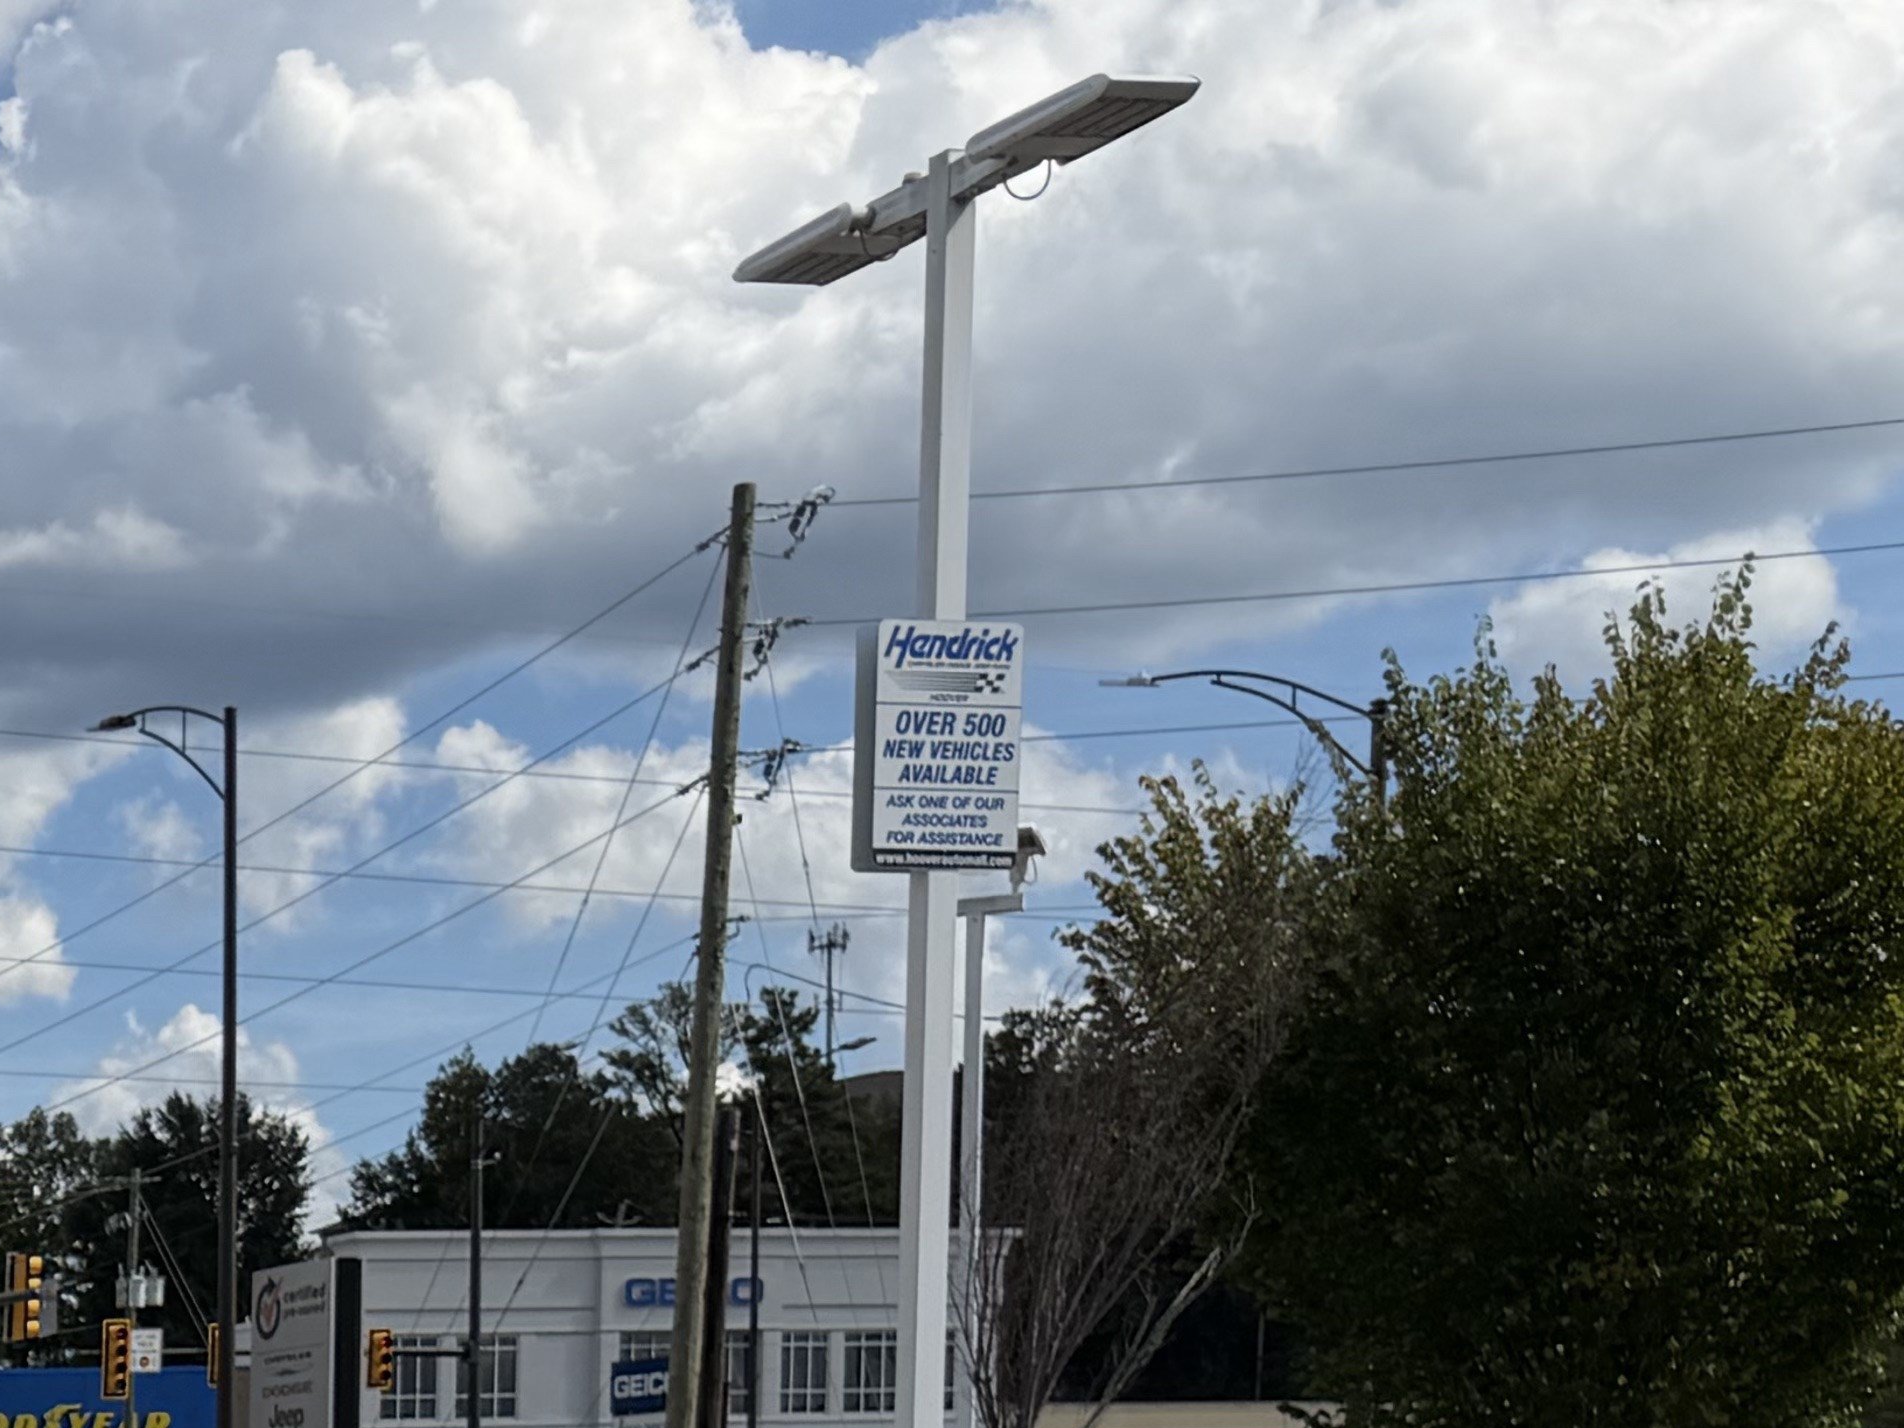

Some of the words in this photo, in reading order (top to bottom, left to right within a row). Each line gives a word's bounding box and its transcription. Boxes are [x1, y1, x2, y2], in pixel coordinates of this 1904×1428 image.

[884, 625, 1019, 668] Hendrick
[896, 710, 956, 735] OVER
[962, 712, 1006, 737] 500
[882, 739, 925, 759] NEW
[929, 741, 1015, 762] VEHICLES
[898, 764, 998, 786] AVAILABLE
[886, 794, 915, 808] ASK
[918, 795, 949, 810] ONE
[952, 796, 972, 810] OF
[974, 796, 1005, 811] OUR
[901, 813, 988, 828] ASSOCIATES
[886, 831, 914, 845] FOR
[917, 832, 1004, 847] ASSISTANCE
[625, 1277, 764, 1307] GEO
[614, 1371, 669, 1399] GEIC
